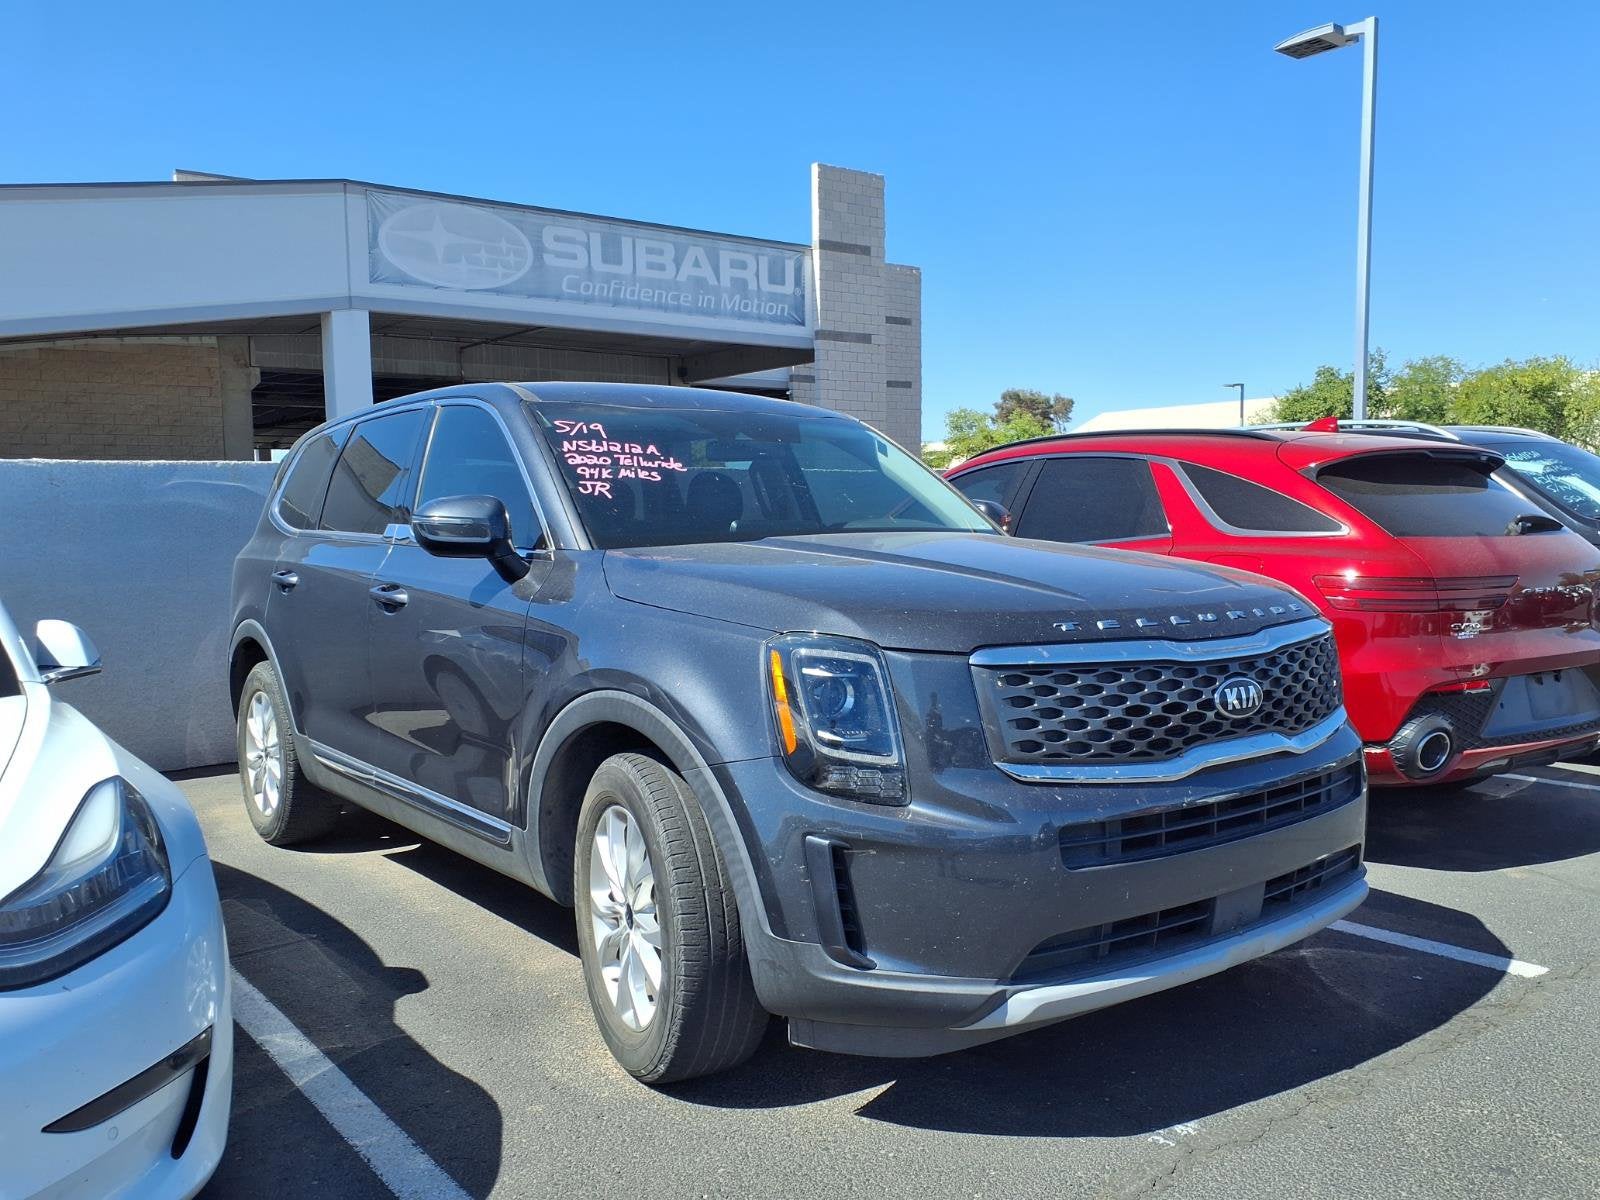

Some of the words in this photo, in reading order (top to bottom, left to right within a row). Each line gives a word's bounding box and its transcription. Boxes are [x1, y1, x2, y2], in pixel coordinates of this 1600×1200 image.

[541, 225, 796, 296] SUBARU
[561, 274, 692, 306] Confidence
[697, 290, 715, 309] in
[720, 293, 789, 317] Motion
[553, 420, 608, 439] 5/19
[564, 453, 612, 466] 2020
[613, 454, 688, 472] Telluride
[618, 468, 662, 482] Miles
[578, 481, 613, 499] JR
[1053, 603, 1302, 632] TELLURIDE
[1224, 685, 1260, 711] KIA
